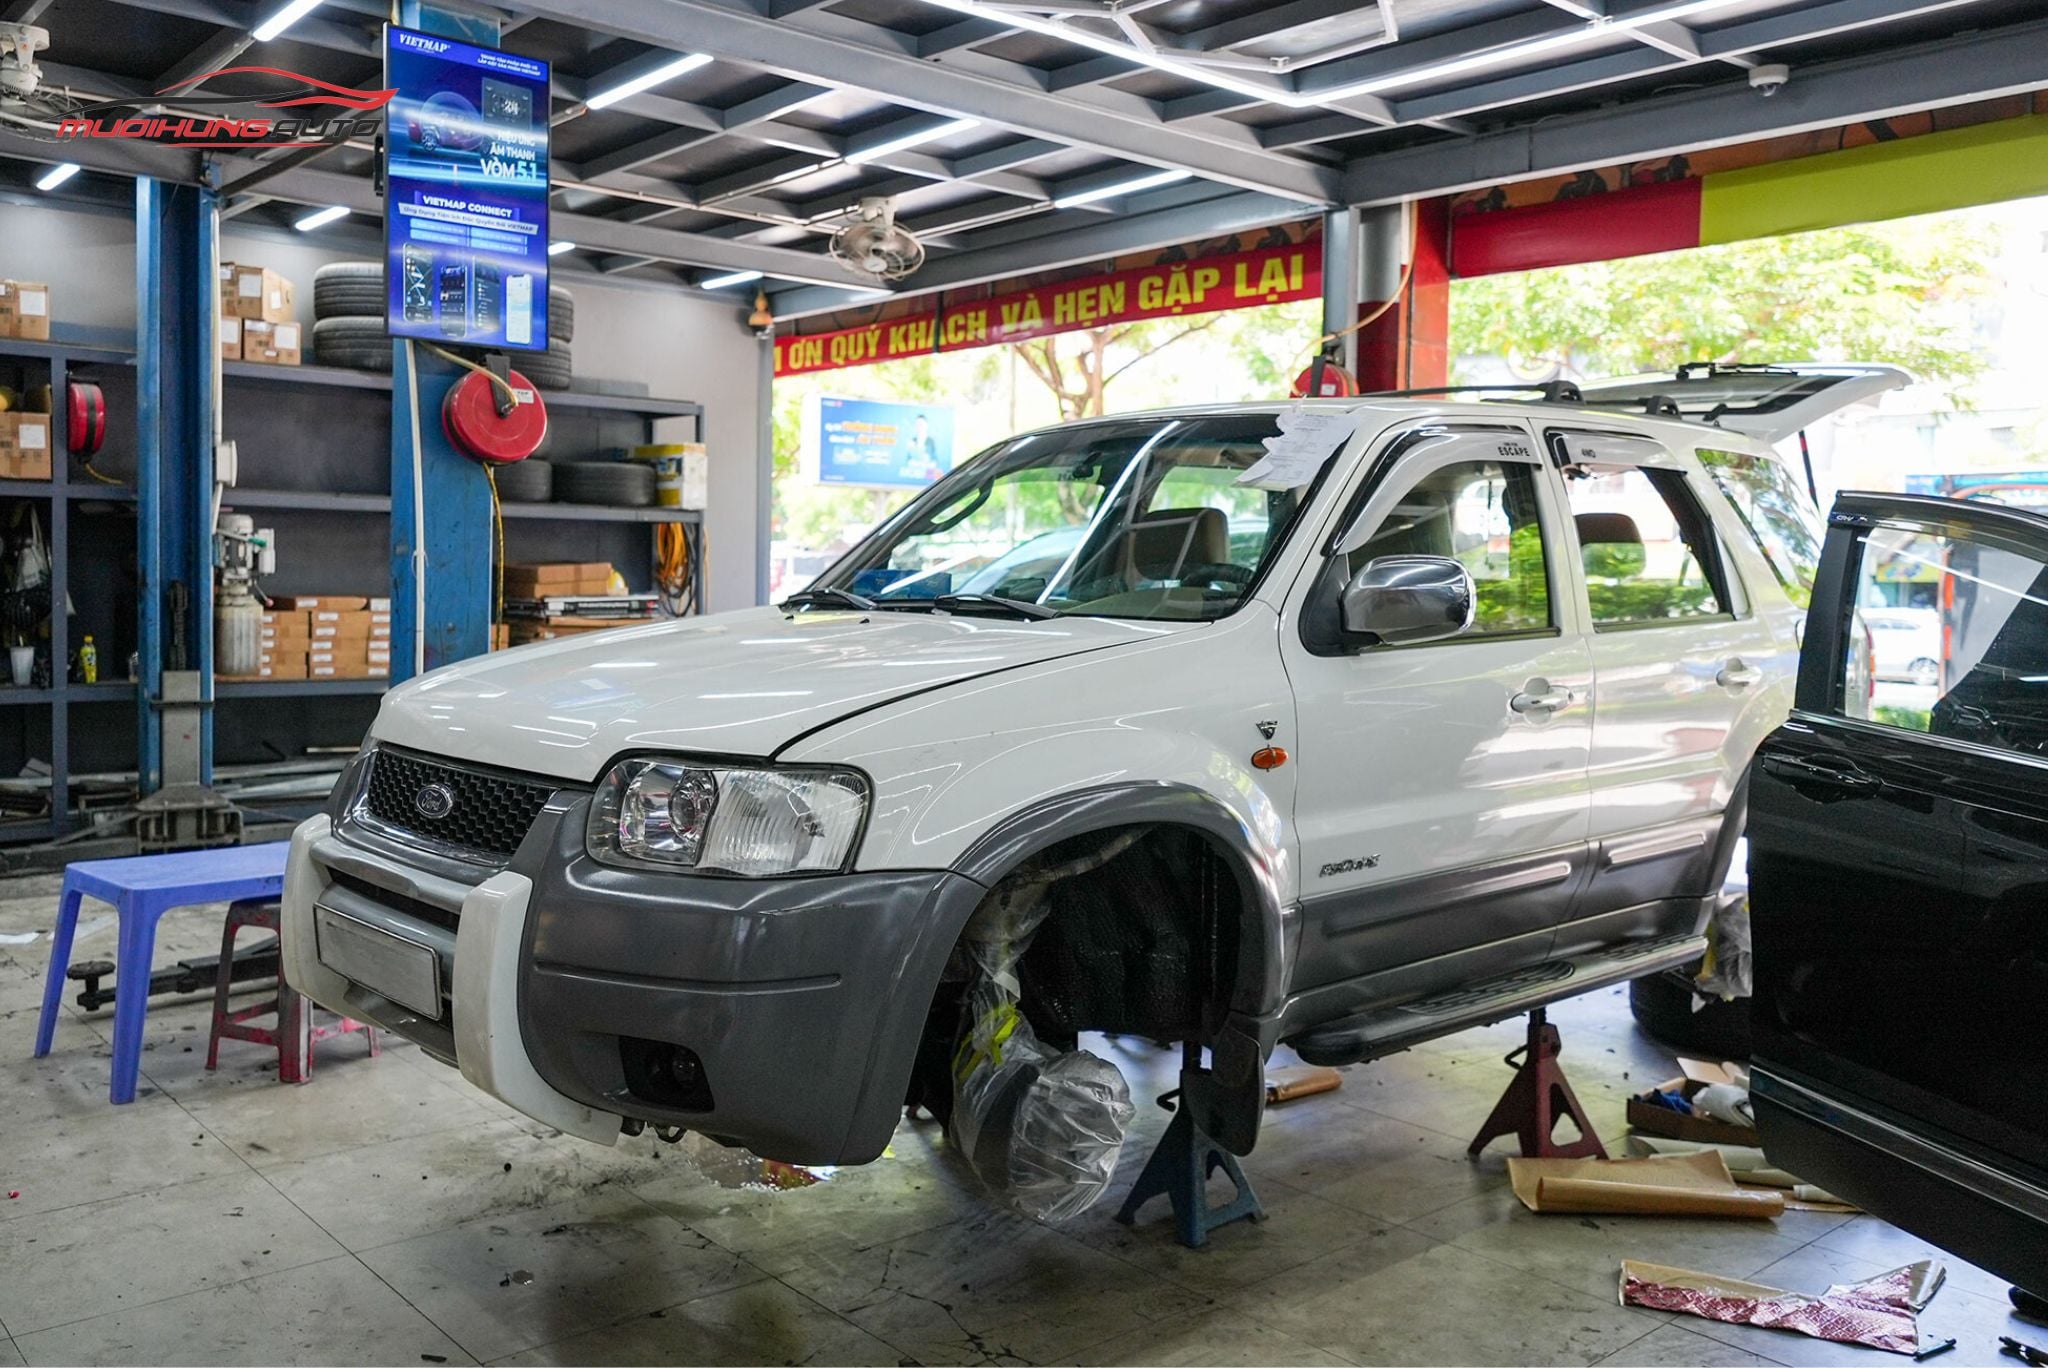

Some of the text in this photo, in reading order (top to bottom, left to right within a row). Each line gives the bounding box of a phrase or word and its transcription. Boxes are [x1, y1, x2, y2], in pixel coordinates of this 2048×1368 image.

[400, 34, 448, 53] VIETMAP
[506, 146, 536, 161] THANH
[480, 156, 537, 181] VÒM 5.1
[423, 195, 512, 218] VIETMAP CONNECT
[788, 337, 822, 370] ƠN
[830, 324, 880, 363] QUÝ
[1001, 296, 1044, 333] VÀ
[1054, 281, 1126, 328] HẸN
[1138, 264, 1220, 312] GẶP
[1234, 254, 1304, 301] LẠI
[1498, 446, 1530, 456] ESCAPE
[422, 790, 442, 811] Ford
